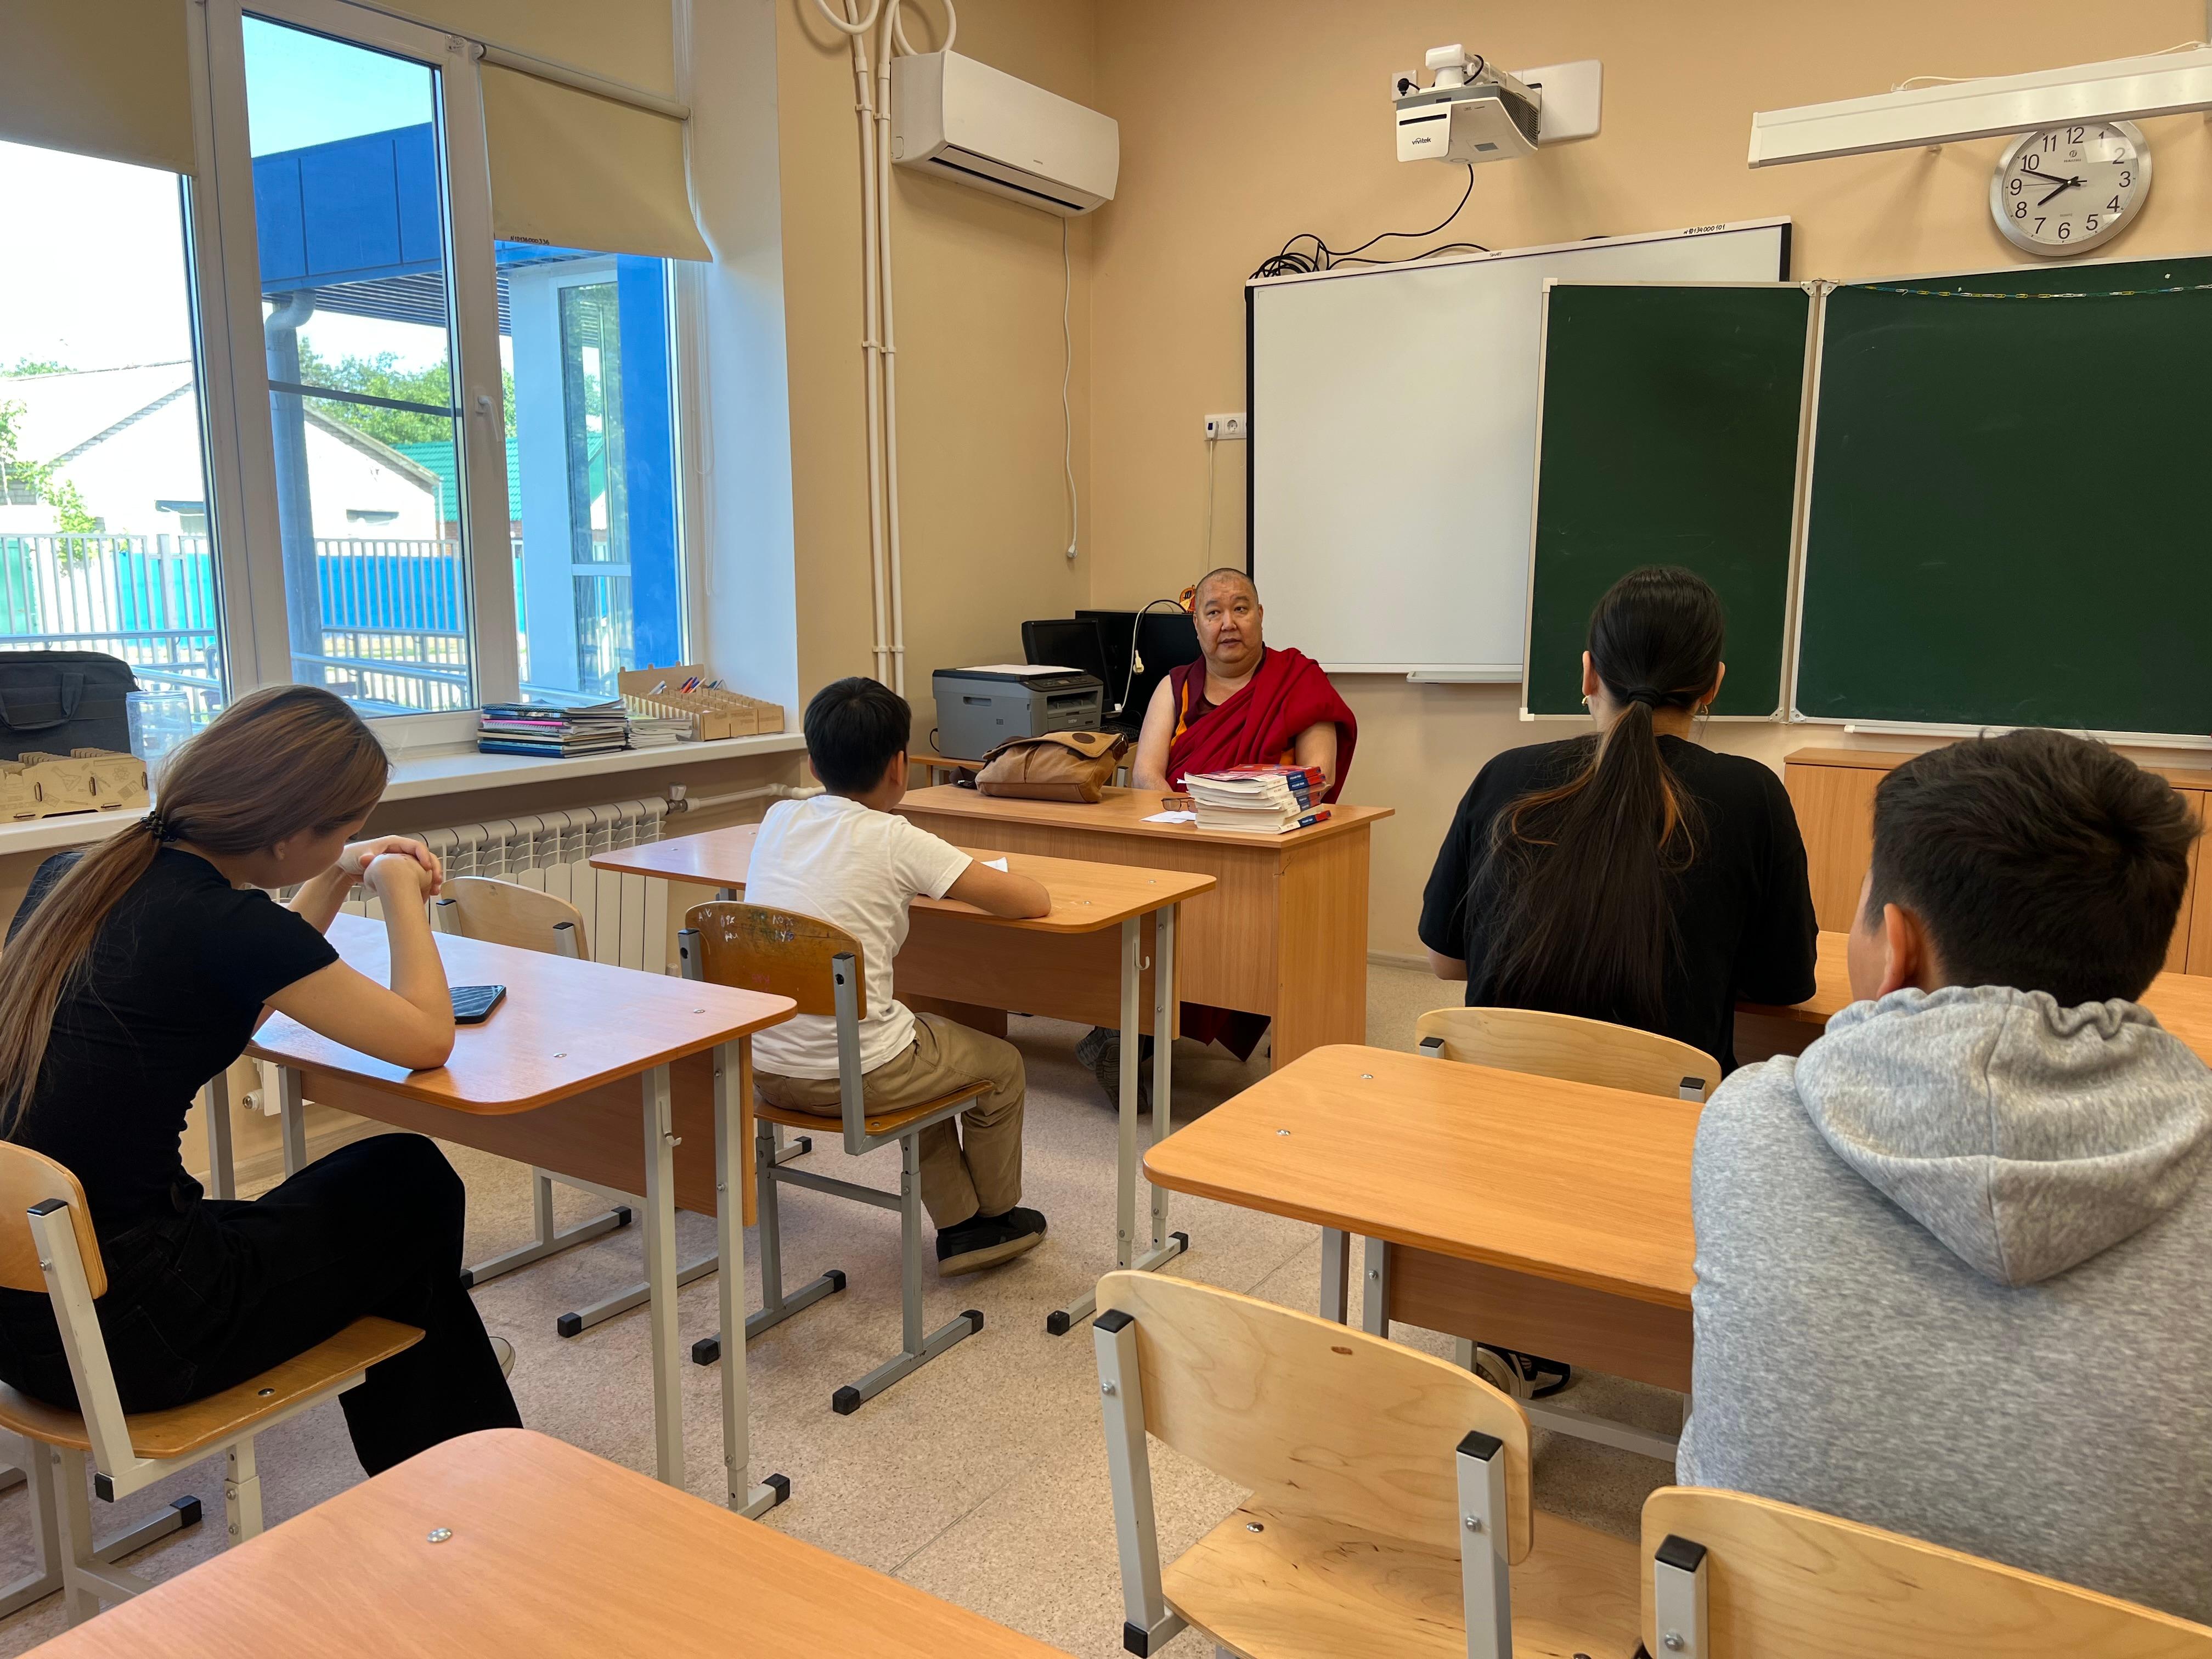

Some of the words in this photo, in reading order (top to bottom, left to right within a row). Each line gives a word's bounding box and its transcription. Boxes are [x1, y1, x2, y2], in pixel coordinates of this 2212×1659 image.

[1412, 137, 1431, 145] vivitek
[2042, 134, 2057, 153] 11
[2066, 127, 2085, 144] 12
[2098, 131, 2104, 148] 1
[2021, 154, 2040, 171] 10
[2112, 147, 2125, 165] 2
[2010, 178, 2022, 196] 9
[2119, 171, 2131, 188] 3
[2015, 201, 2027, 218] 8
[2106, 195, 2120, 212] 4
[2034, 217, 2046, 234] 7
[2058, 222, 2071, 239] 6
[2085, 213, 2098, 231] 5
